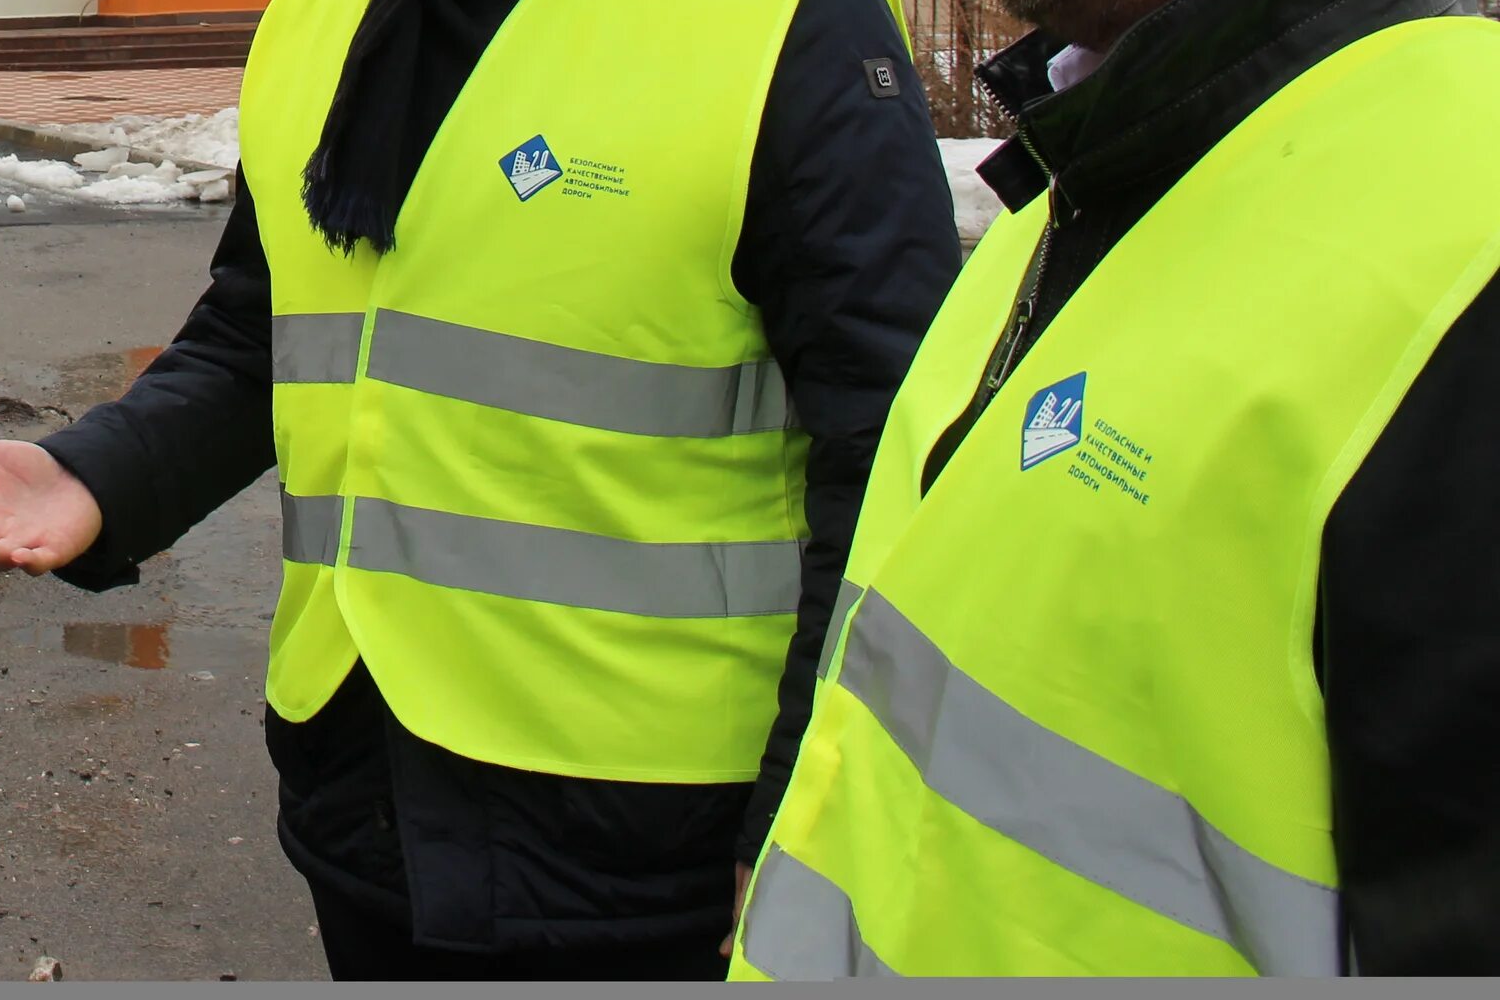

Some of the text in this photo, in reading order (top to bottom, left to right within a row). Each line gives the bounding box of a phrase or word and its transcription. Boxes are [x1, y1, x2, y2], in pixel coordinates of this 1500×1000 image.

[530, 150, 549, 170] 2.0
[569, 157, 618, 173] БЕЗОПАСНЫЕ
[564, 178, 630, 197] АВТОМОБИЛЬНЫЕ
[566, 167, 624, 184] КАЧЕСТВЕННЫЕ
[562, 188, 592, 199] ДОРОГИ
[1049, 397, 1082, 428] 2.0
[1094, 419, 1152, 463] БЕЗОПАСНЫЕ И
[1085, 433, 1147, 482] КАЧЕСТВЕННЫЕ
[1068, 464, 1100, 492] ДОРОГИ
[1076, 451, 1150, 505] АВТОМОБИЛЬНЫЕ
